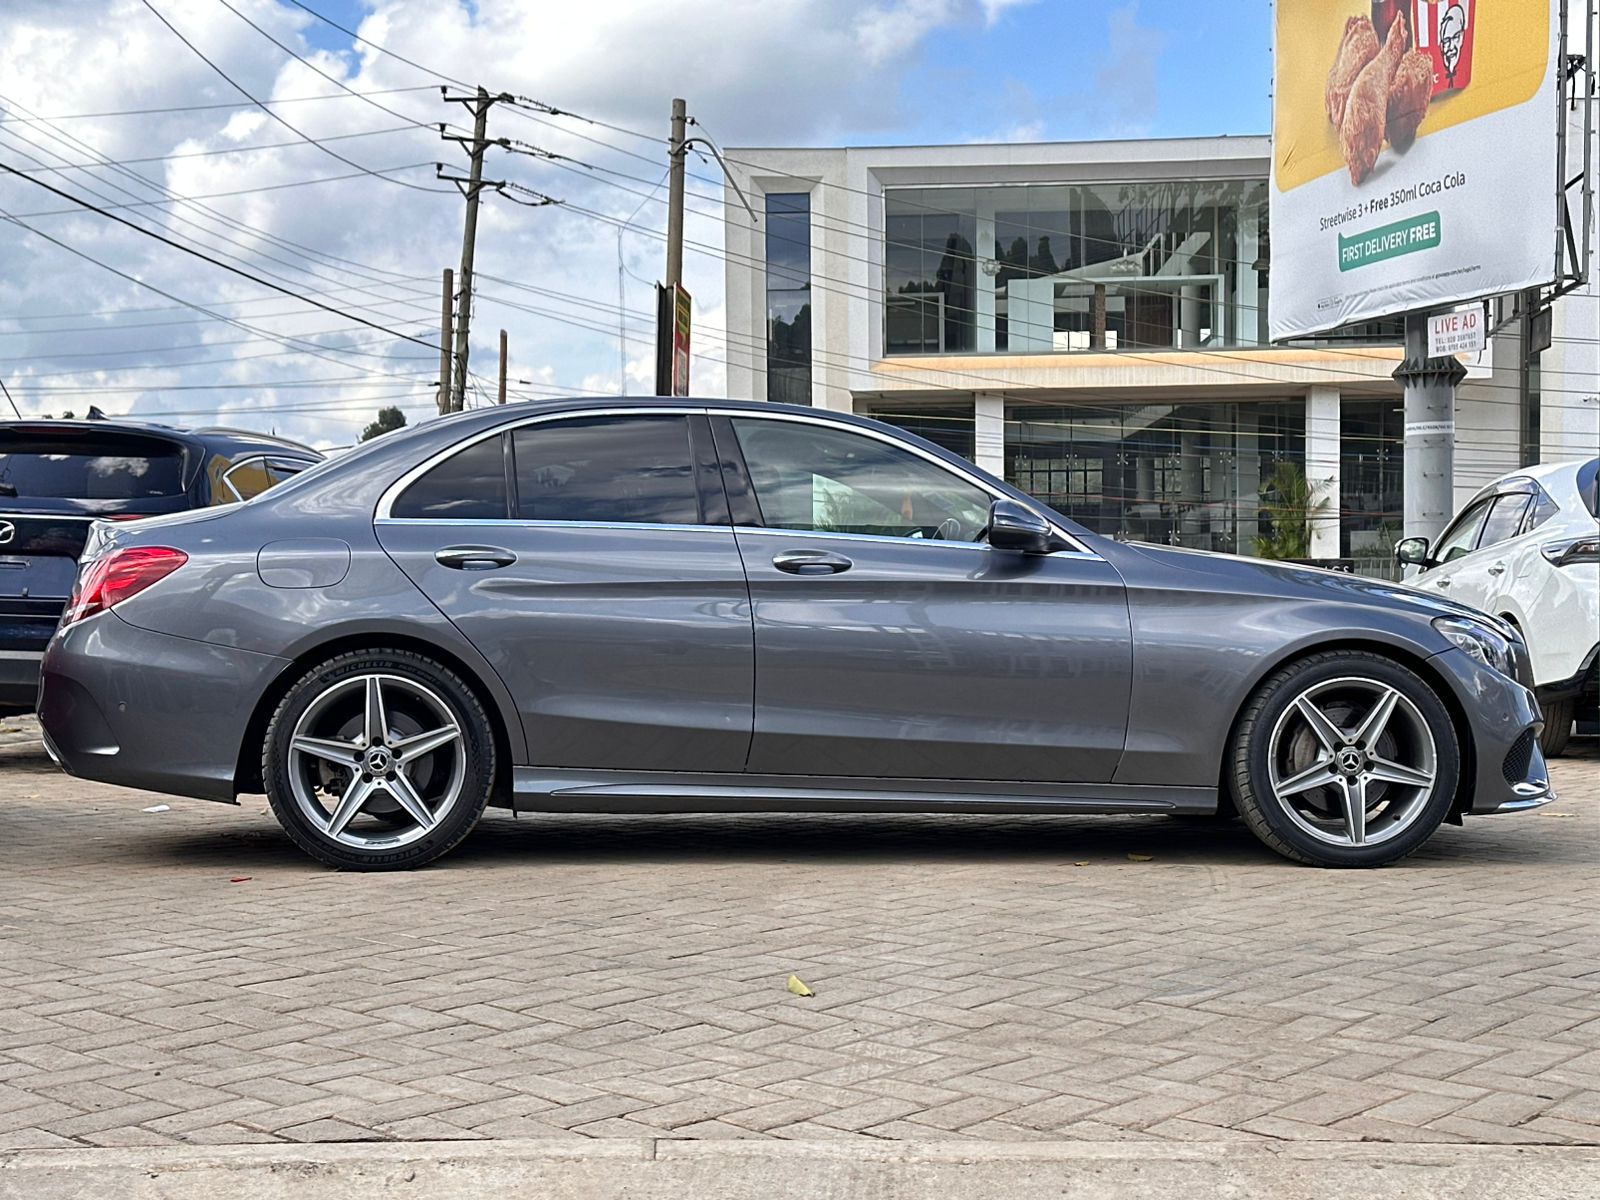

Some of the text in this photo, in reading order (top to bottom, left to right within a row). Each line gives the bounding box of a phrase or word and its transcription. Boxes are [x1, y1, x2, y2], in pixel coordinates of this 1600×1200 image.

[1320, 207, 1357, 231] Streetwise
[1358, 204, 1363, 218] 3
[1370, 198, 1389, 214] Free
[1390, 184, 1417, 207] 350ml
[1419, 180, 1442, 198] Coca
[1444, 171, 1466, 190] Cola
[1342, 222, 1436, 263] FIRST DELIVERY FREE
[1435, 313, 1477, 334] LIVE AD
[335, 660, 393, 677] MICHELIN
